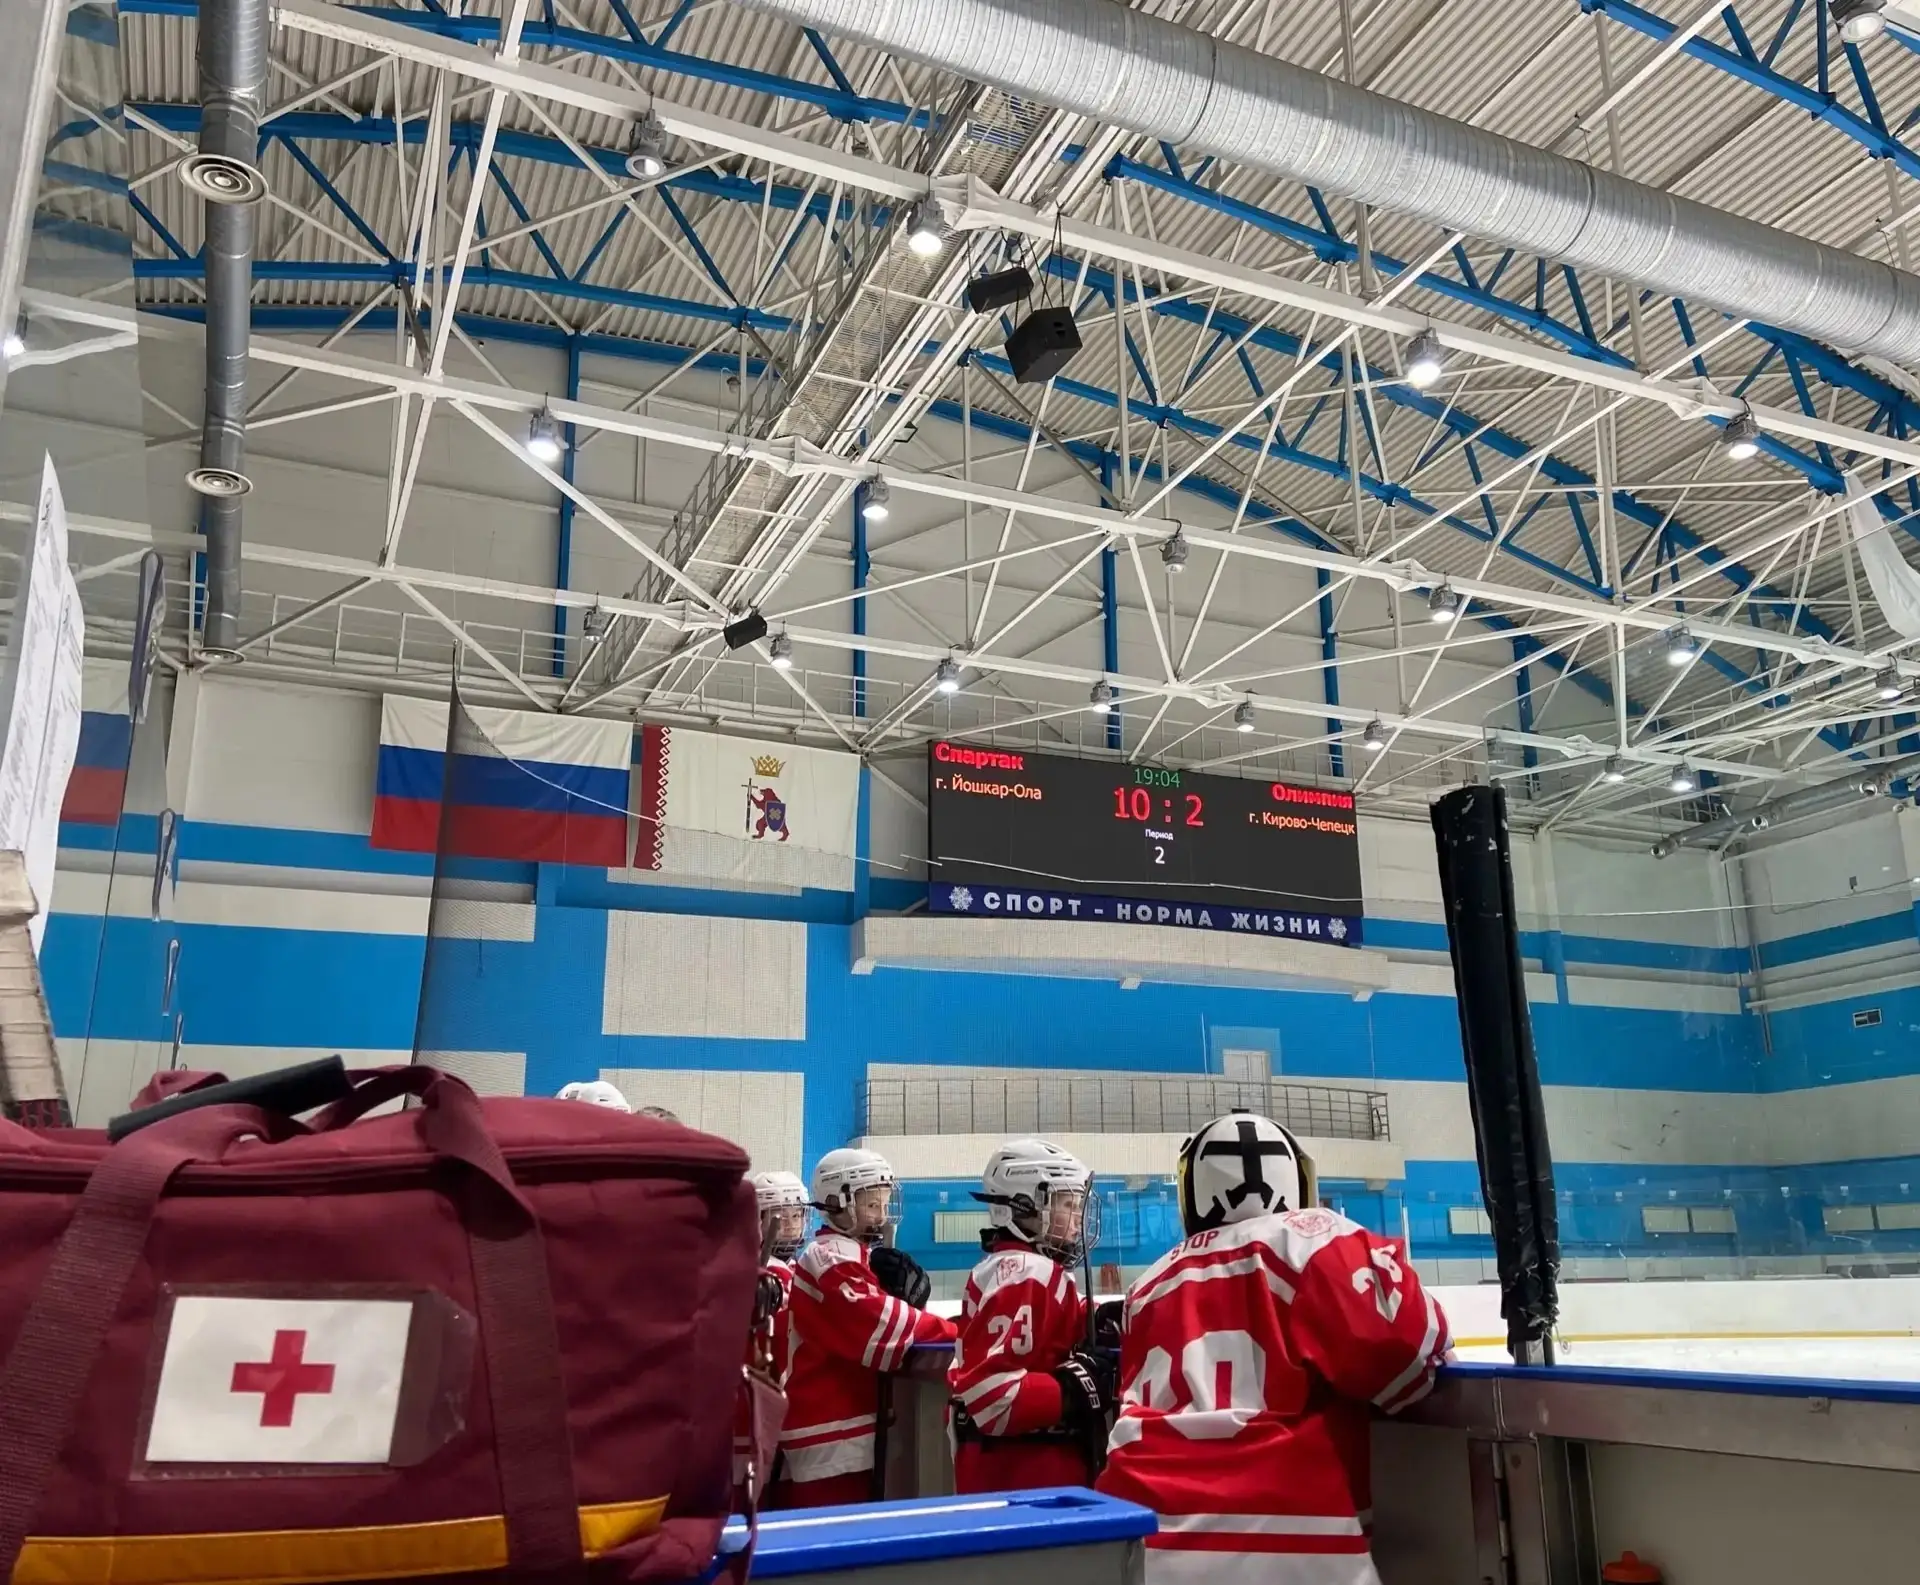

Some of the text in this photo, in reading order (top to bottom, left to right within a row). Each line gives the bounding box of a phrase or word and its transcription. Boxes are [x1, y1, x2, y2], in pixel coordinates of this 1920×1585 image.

[935, 742, 1024, 770] Спартак
[935, 773, 1042, 800] г. Йошкар-Ола
[1134, 767, 1180, 788] 19:04
[1114, 787, 1150, 821] 10
[1186, 795, 1204, 826] 2
[1272, 783, 1352, 809] Олимпия
[1145, 828, 1174, 840] Период
[1249, 811, 1355, 836] г. Кирово-Чепецк
[1154, 846, 1165, 864] 2
[983, 891, 1081, 916] СПОРТ
[1116, 903, 1214, 927] НОРМА
[1231, 911, 1321, 936] ЖИЗНИ
[987, 1304, 1034, 1358] 23
